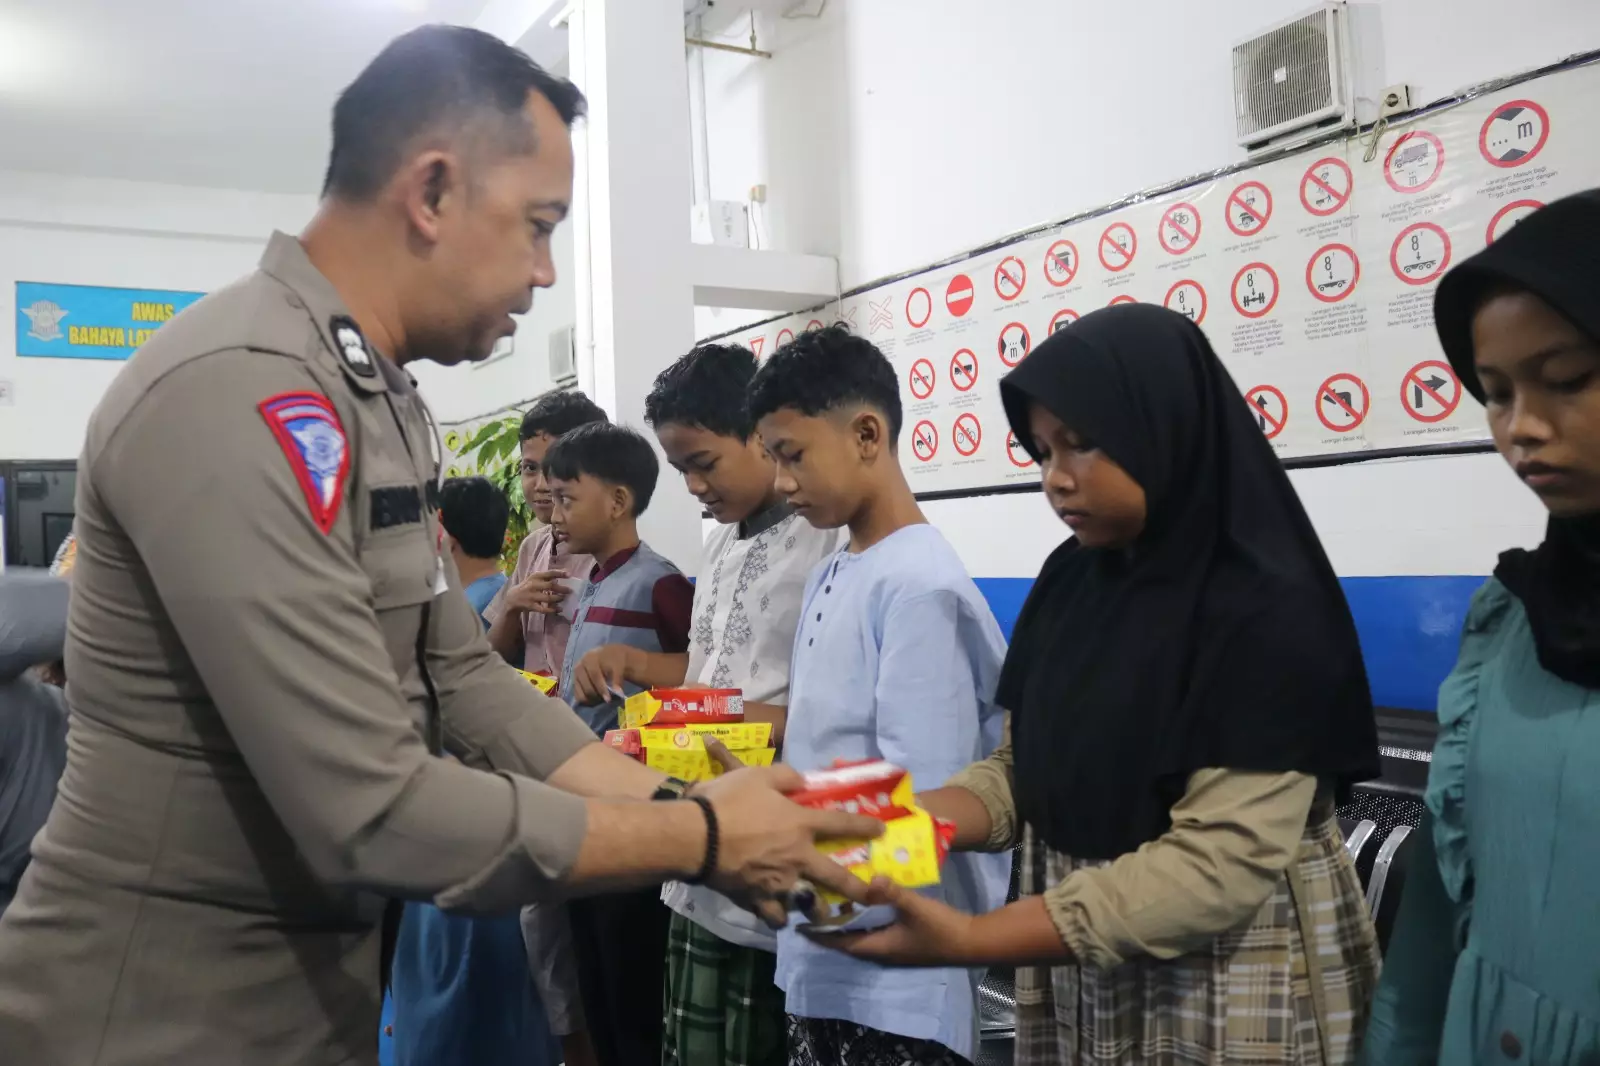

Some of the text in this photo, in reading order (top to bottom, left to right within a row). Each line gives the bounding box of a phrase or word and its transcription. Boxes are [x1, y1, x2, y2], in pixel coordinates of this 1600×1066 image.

[1517, 121, 1532, 139] m
[1410, 234, 1420, 252] 8
[1325, 255, 1333, 272] 8
[1247, 273, 1255, 288] 8
[132, 302, 175, 322] AWAS
[68, 325, 125, 347] BAHAYA
